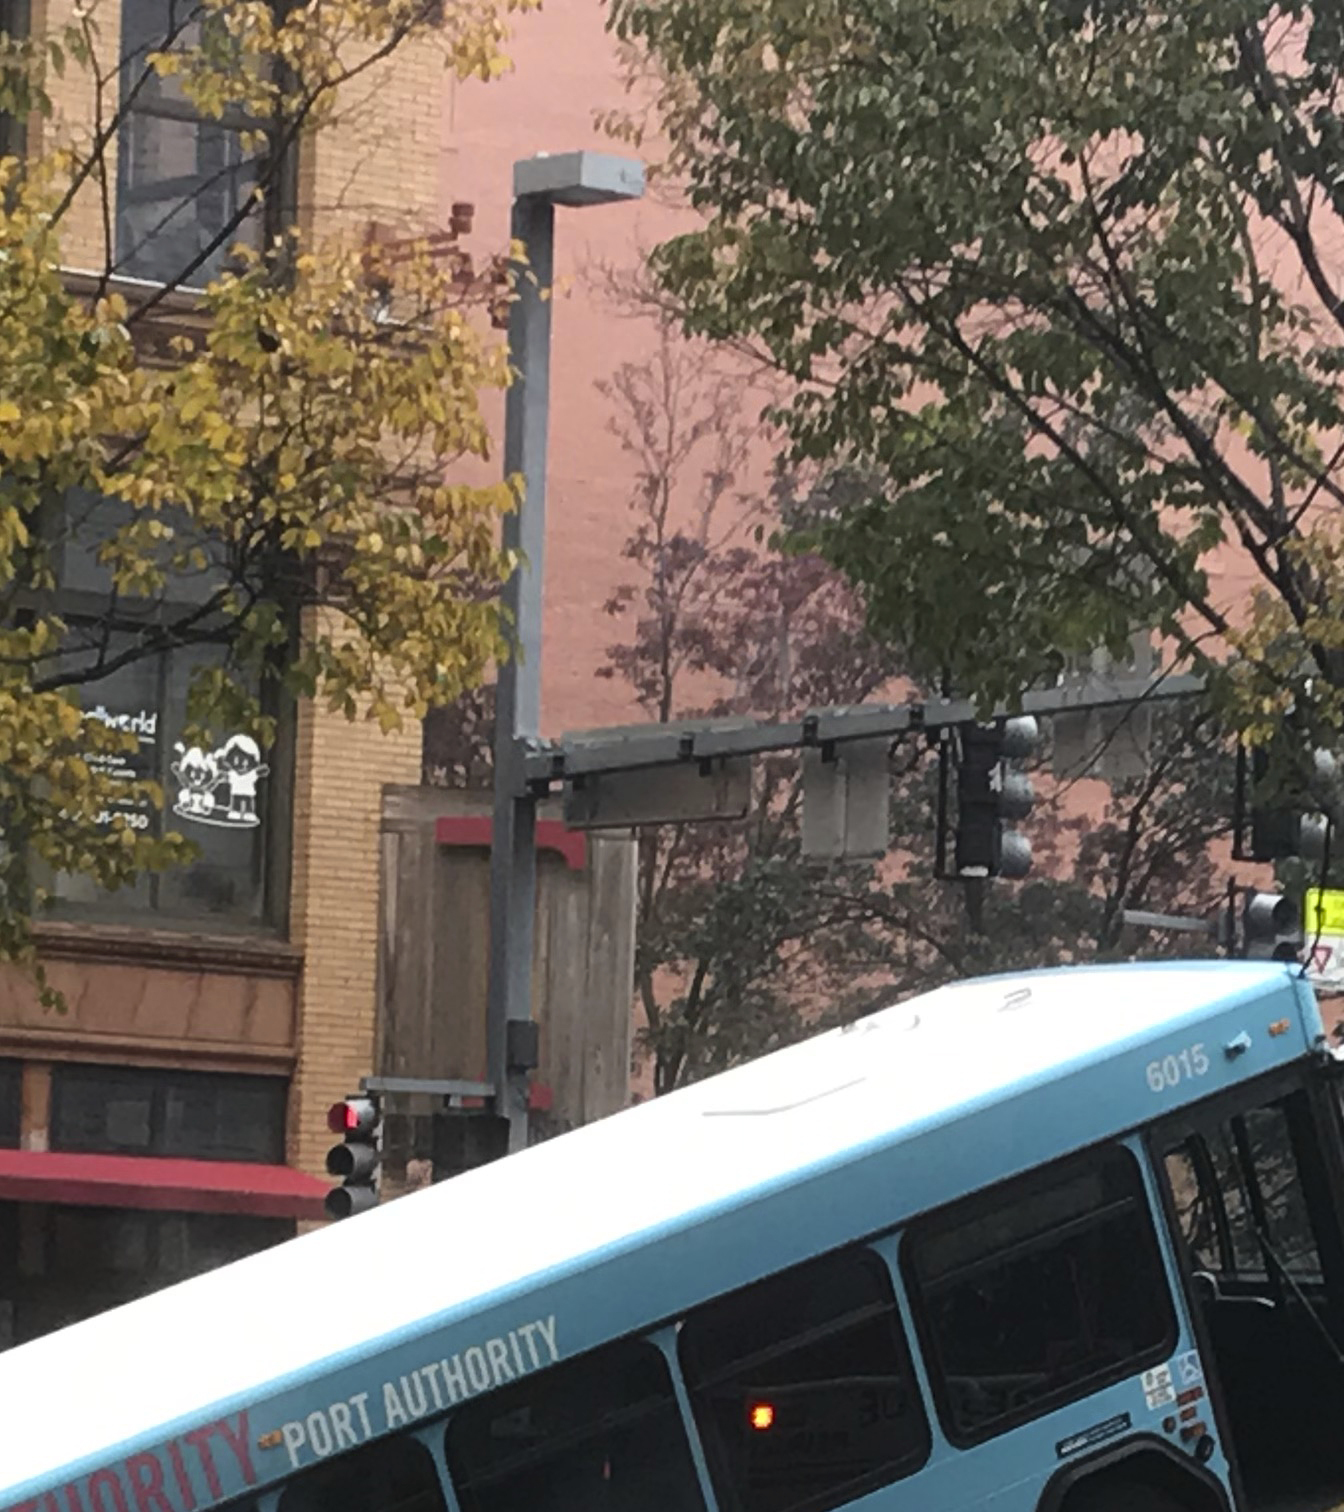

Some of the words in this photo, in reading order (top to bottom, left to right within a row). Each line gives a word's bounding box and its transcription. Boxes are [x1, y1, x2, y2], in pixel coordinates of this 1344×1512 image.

[1146, 1043, 1209, 1092] 6015
[282, 1392, 371, 1468] PORT
[382, 1315, 559, 1428] AUTHORITY
